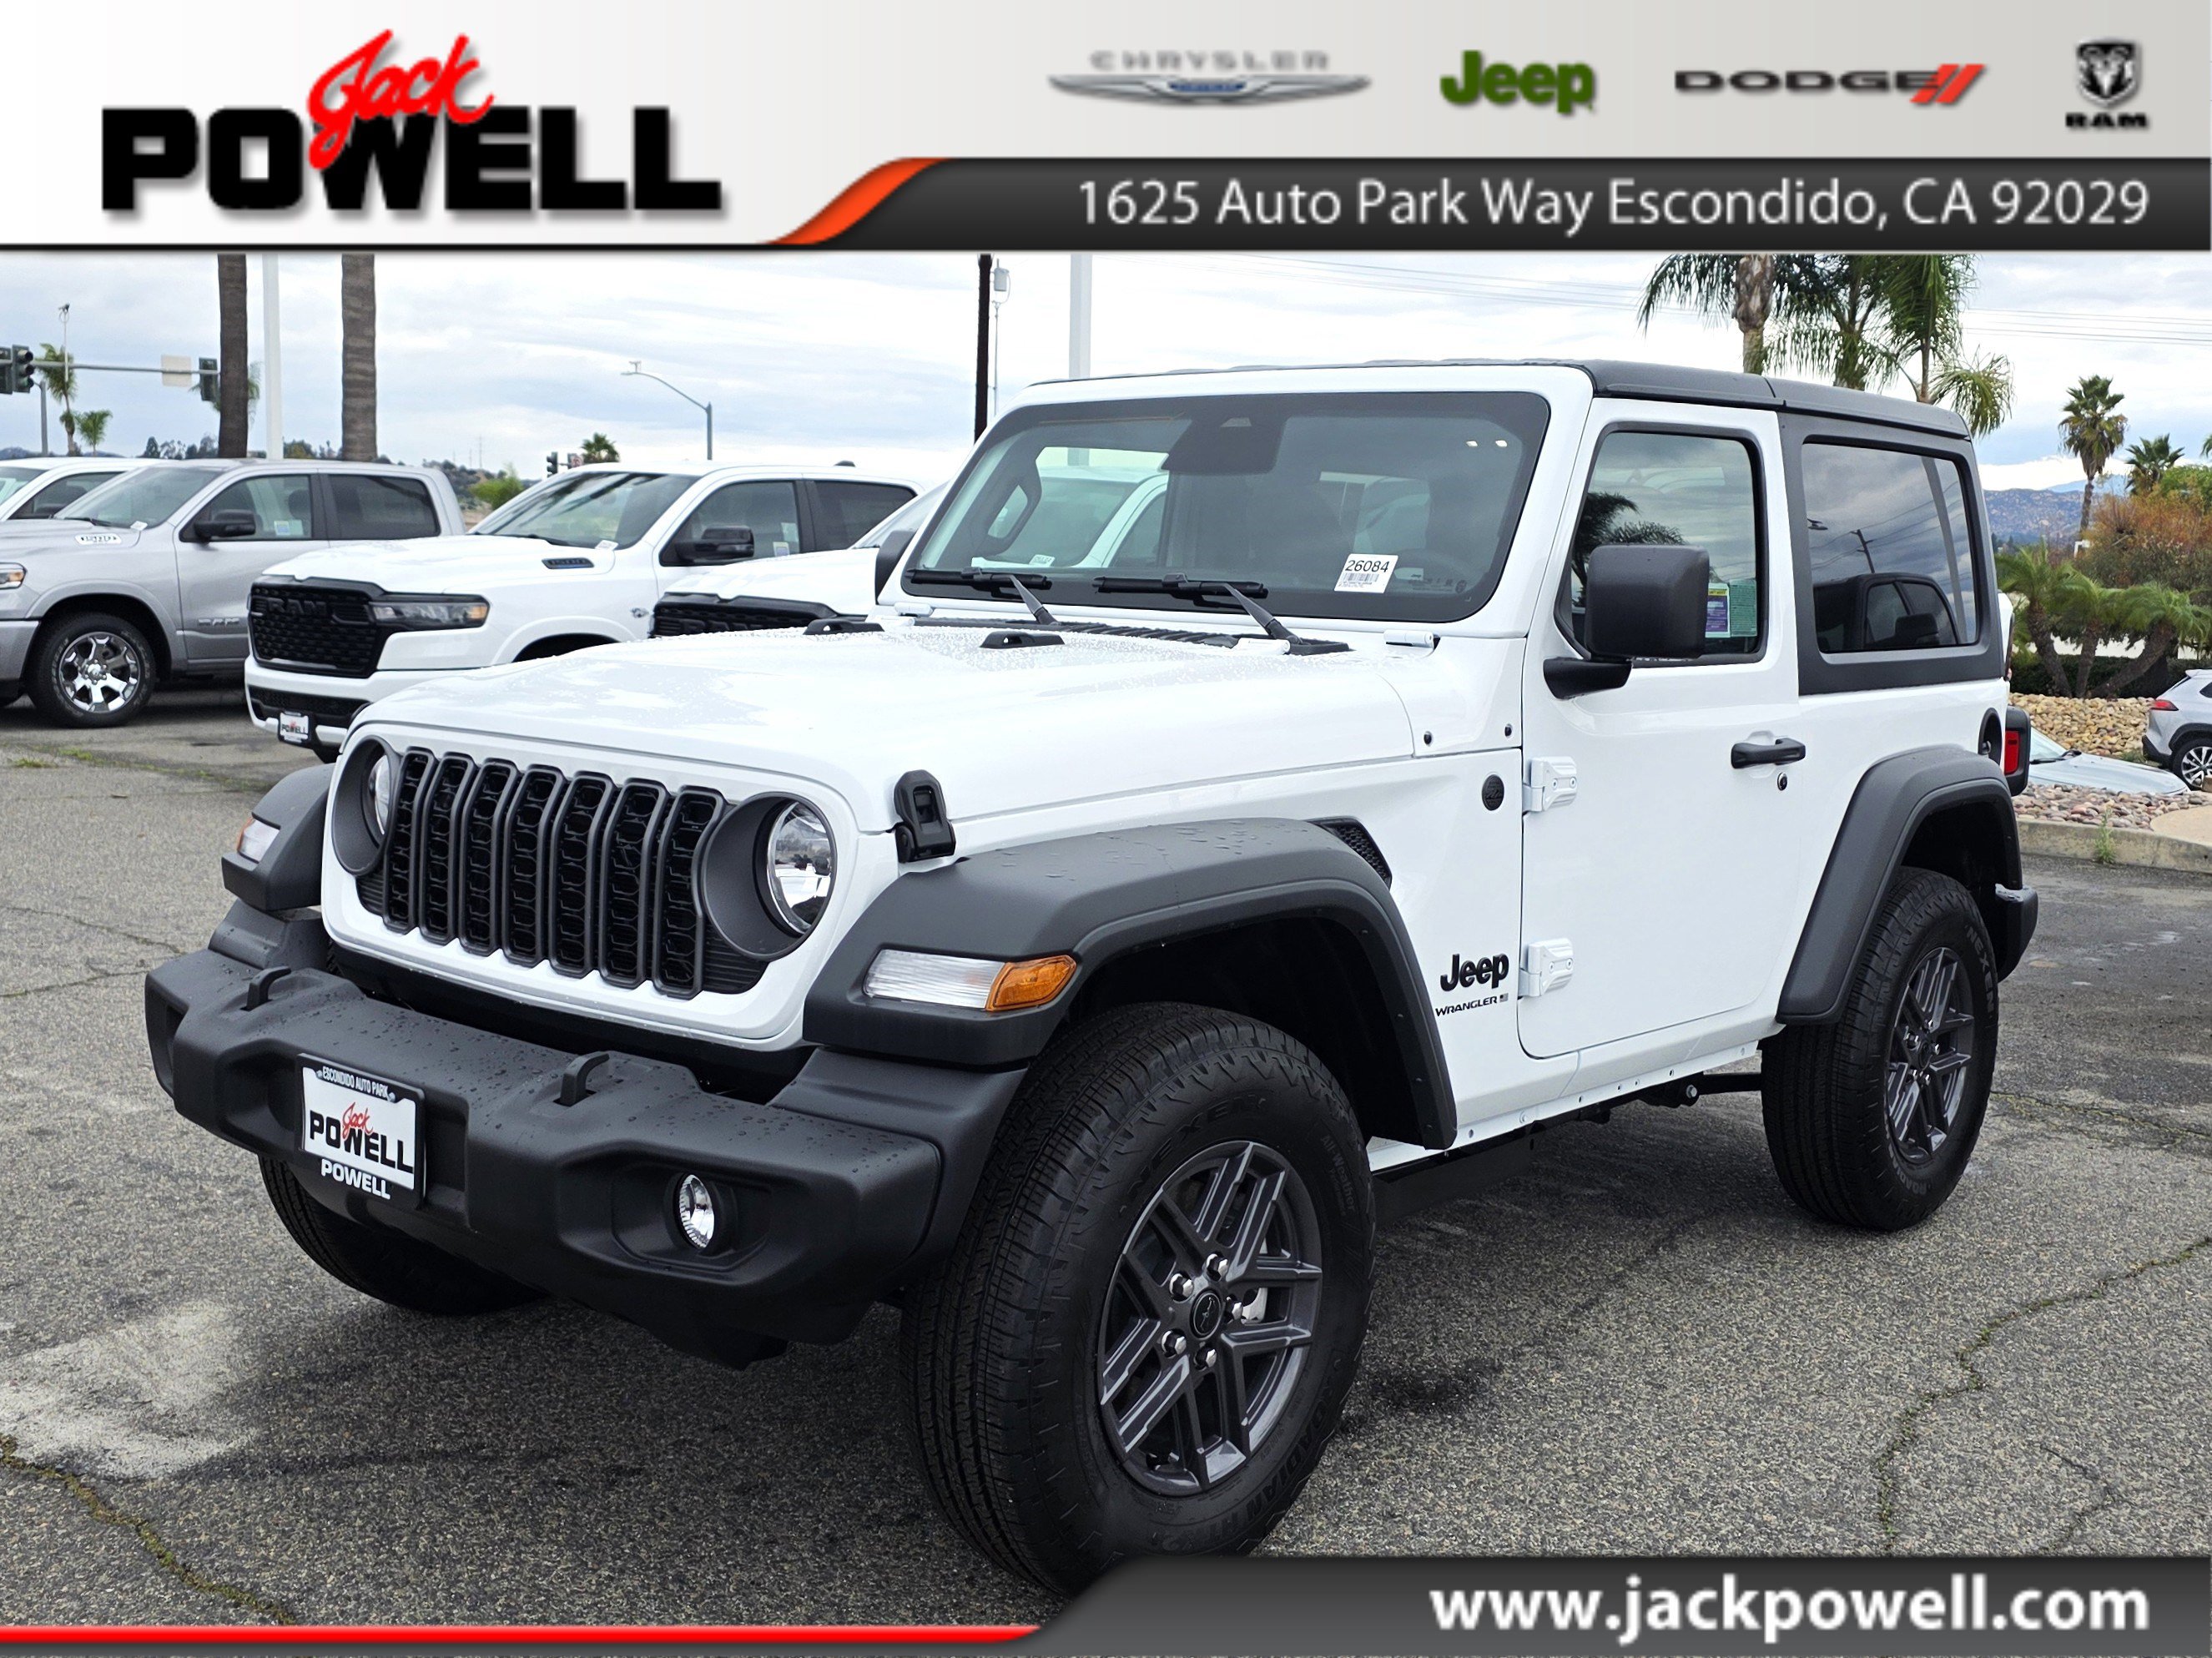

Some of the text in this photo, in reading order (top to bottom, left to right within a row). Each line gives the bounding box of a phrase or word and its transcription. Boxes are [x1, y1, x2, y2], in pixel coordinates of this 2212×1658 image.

[1345, 560, 1390, 573] 26084
[1440, 953, 1509, 991] Jeep
[1435, 995, 1498, 1017] WRANGLER
[322, 1066, 355, 1088] ESCONDIDO
[355, 1077, 370, 1095] AUTO
[342, 1101, 374, 1141] Jack
[310, 1110, 414, 1175] POWELL
[320, 1158, 391, 1200] POWELL
